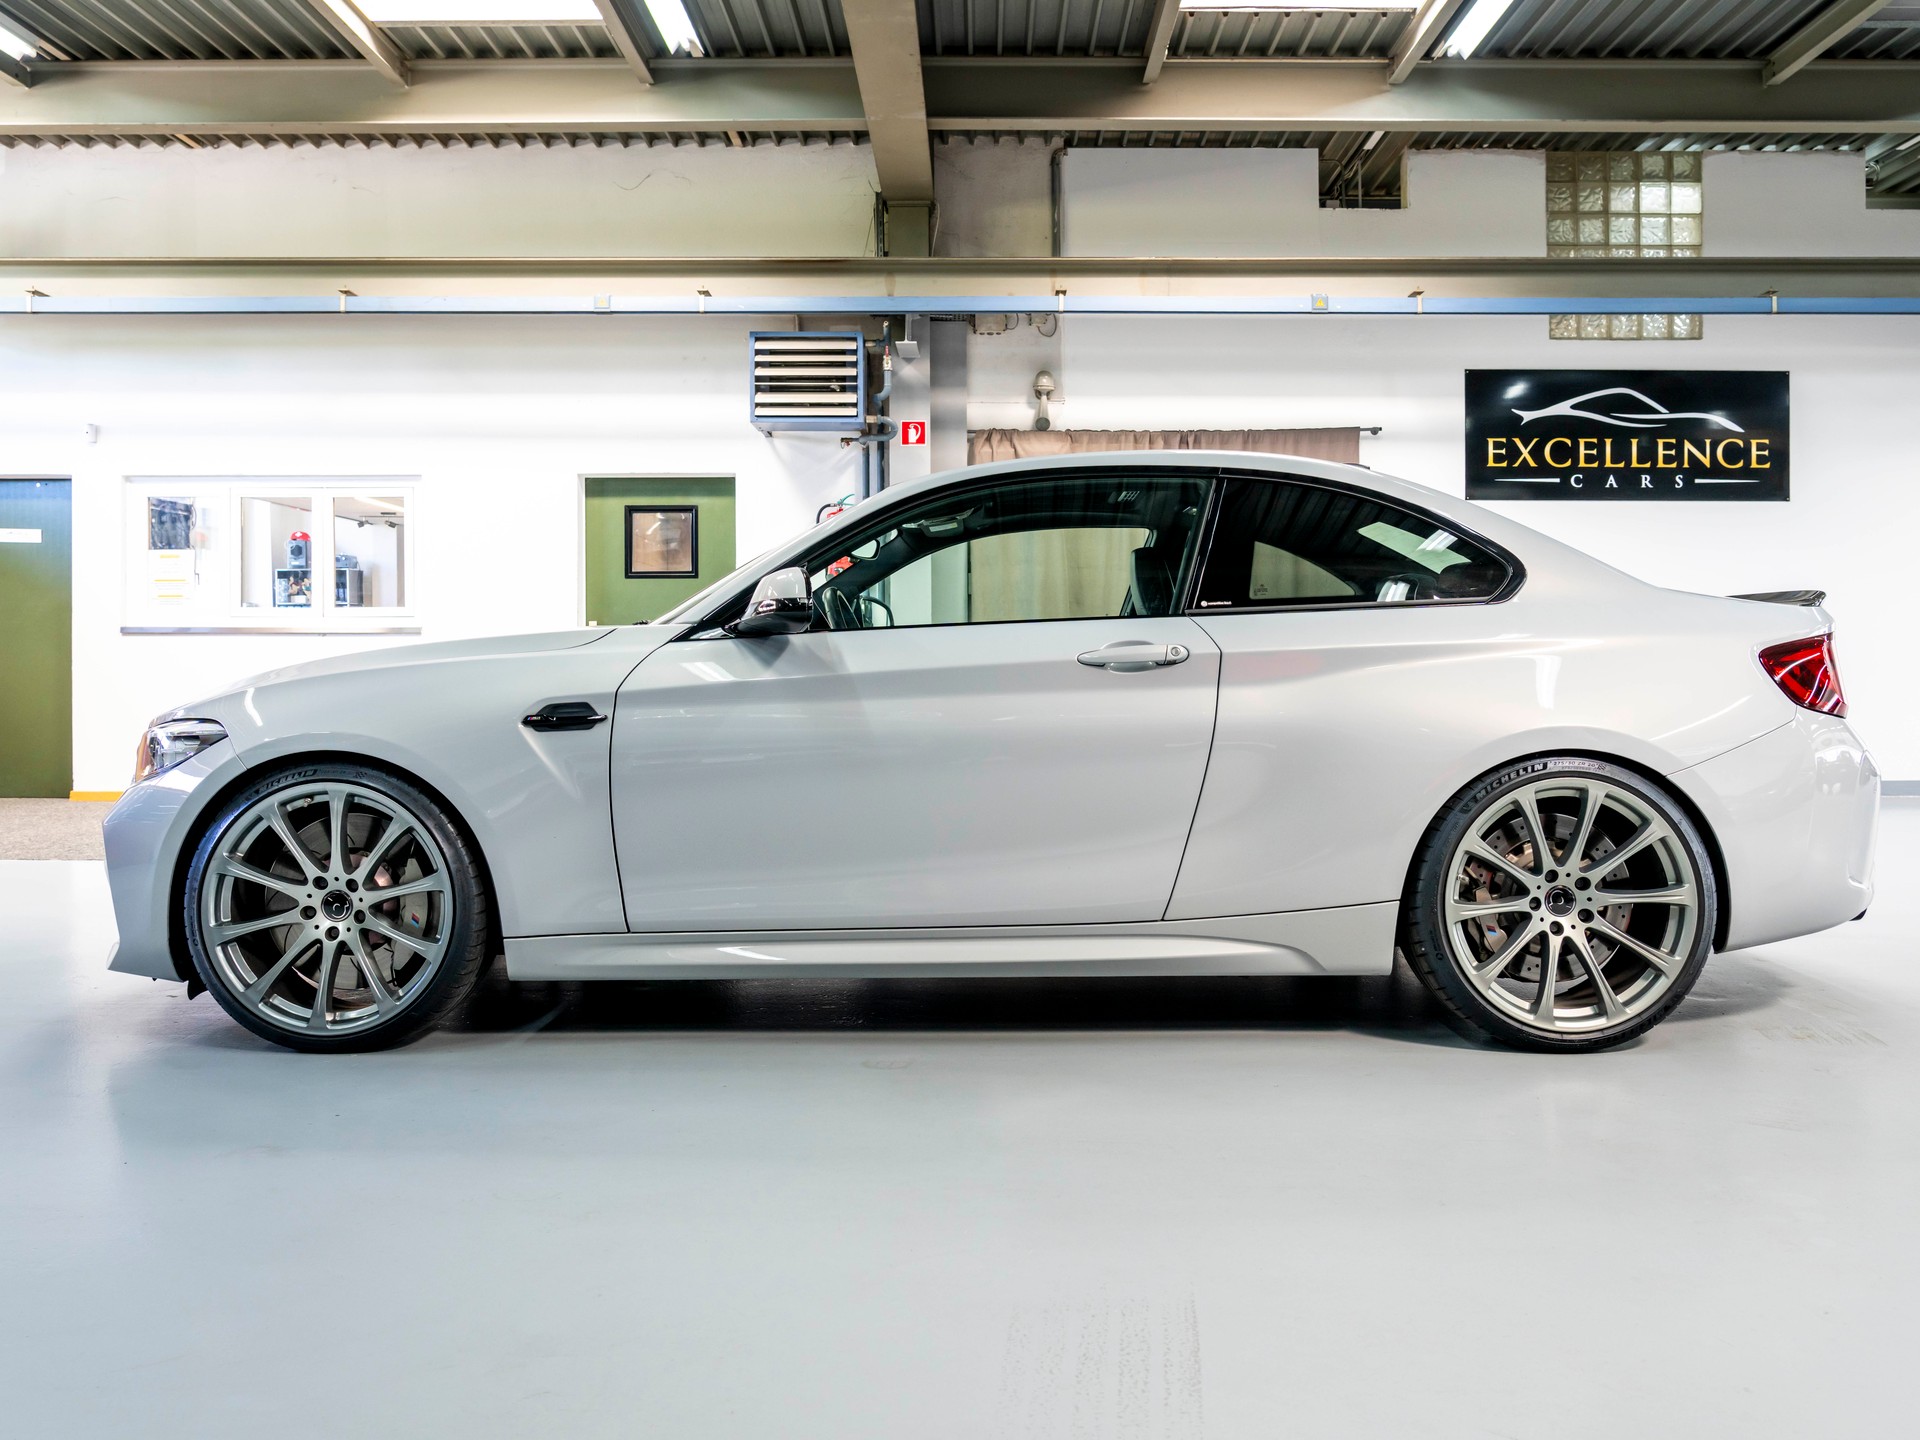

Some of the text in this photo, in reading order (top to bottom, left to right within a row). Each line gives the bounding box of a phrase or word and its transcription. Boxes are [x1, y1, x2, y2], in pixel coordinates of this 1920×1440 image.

[1486, 437, 1771, 469] EXCELLENCE
[1570, 474, 1683, 489] CARS
[1476, 763, 1543, 800] MICHELIN
